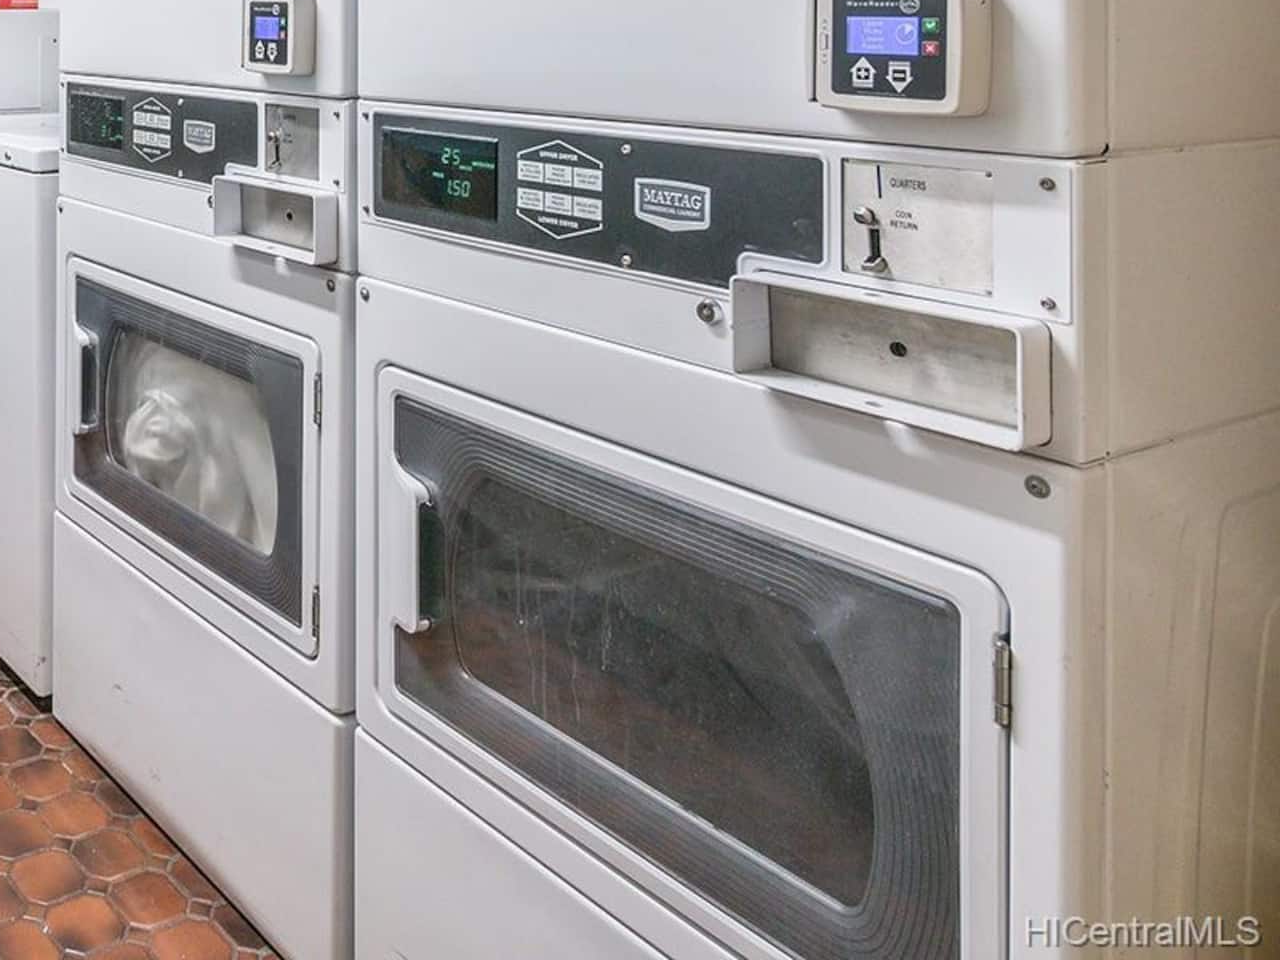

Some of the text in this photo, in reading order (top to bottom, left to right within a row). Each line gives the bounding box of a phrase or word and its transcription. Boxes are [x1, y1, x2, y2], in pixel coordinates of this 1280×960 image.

[441, 147, 461, 166] 25
[890, 178, 927, 191] QUARTERS
[643, 188, 703, 210] MAYTAG
[895, 209, 913, 220] COIN
[890, 220, 919, 231] RETURN
